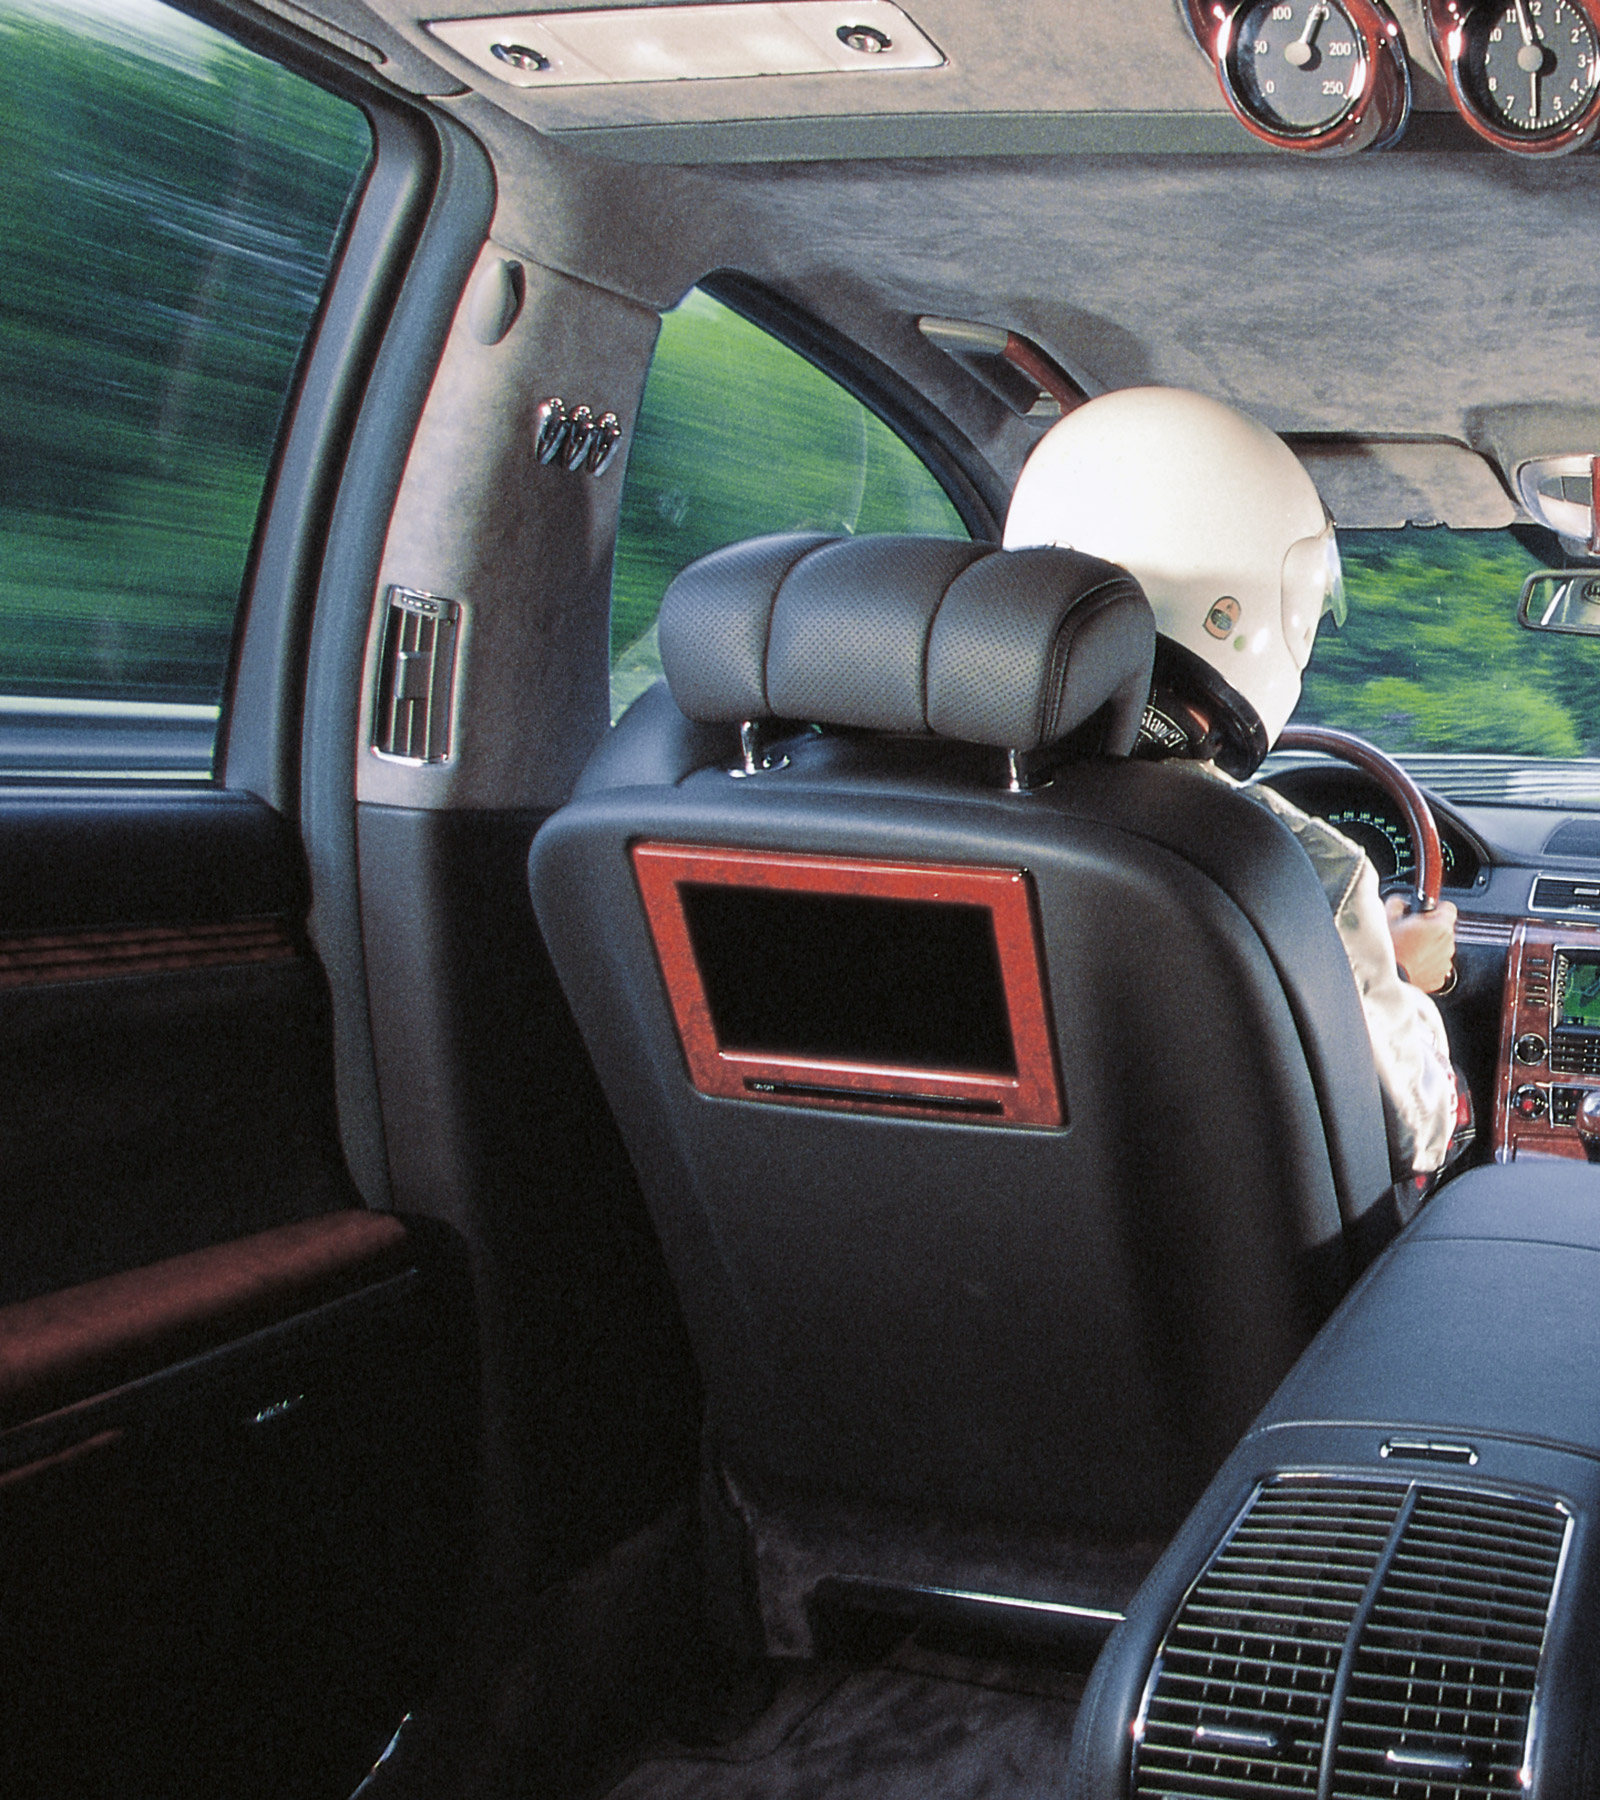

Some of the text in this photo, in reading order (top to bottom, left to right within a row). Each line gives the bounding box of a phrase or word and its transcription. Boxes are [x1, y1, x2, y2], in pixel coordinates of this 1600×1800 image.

[1272, 7, 1292, 20] 100
[1506, 9, 1517, 23] 11
[1555, 9, 1561, 24] 1
[1571, 29, 1580, 43] 2
[1329, 42, 1351, 56] 200
[1578, 53, 1586, 68] 3
[1266, 80, 1274, 93] 0
[1322, 82, 1343, 95] 250
[1488, 77, 1497, 91] 8
[1570, 78, 1579, 92] 4
[1506, 96, 1515, 110] 7
[1553, 96, 1562, 110] 5
